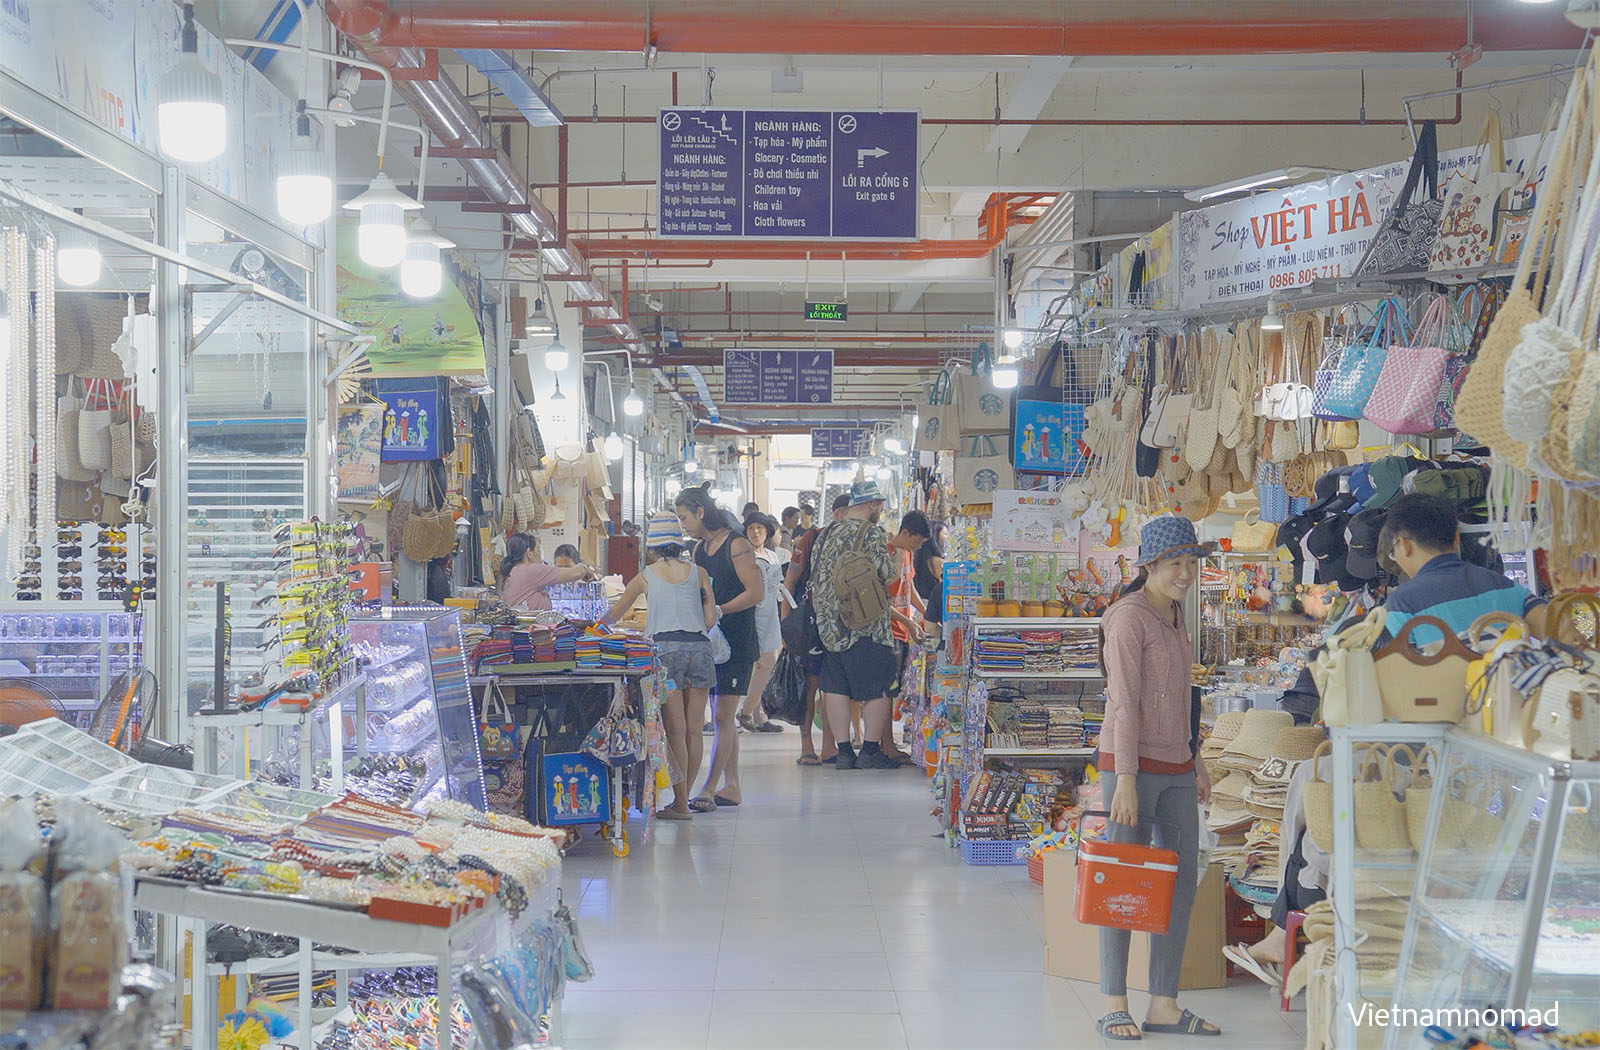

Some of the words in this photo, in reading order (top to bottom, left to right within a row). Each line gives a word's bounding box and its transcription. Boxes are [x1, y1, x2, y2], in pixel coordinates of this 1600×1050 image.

[754, 120, 788, 132] NGÀNH
[792, 120, 822, 132] HÀNG:
[754, 136, 768, 149] Tạp
[792, 137, 804, 149] Mỹ
[806, 135, 827, 149] phẩm
[674, 153, 700, 164] NGÀNH
[702, 153, 726, 164] HÀNG:
[755, 153, 784, 165] Glocery
[791, 153, 827, 164] Cosmetic
[754, 168, 764, 179] Đồ
[766, 169, 783, 179] chơi
[785, 168, 804, 179] thiếu
[807, 169, 818, 179] nhi
[842, 173, 857, 187] LỐI
[860, 176, 872, 187] RA
[875, 172, 899, 188] CỔNG
[902, 176, 909, 187] 6
[754, 184, 786, 195] Children
[789, 186, 801, 196] toy
[856, 191, 870, 200] Exit
[872, 192, 888, 203] gate
[890, 192, 895, 200] 6
[753, 201, 768, 210] Hoa
[771, 200, 782, 210] vải
[754, 216, 775, 227] Cloth
[777, 217, 806, 227] flowers
[1211, 221, 1250, 252] Shop
[1250, 198, 1318, 252] VIỆT
[1327, 180, 1373, 235] HÀ
[1204, 269, 1216, 282] TẠP
[1217, 266, 1229, 279] HÓA
[1234, 263, 1244, 276] MỸ
[1244, 260, 1261, 275] NGHỆ
[1266, 256, 1277, 270] MỸ
[1278, 252, 1297, 267] PHẨM
[1317, 245, 1334, 261] NIỆM
[1218, 283, 1237, 297] ĐIỆN
[1269, 272, 1295, 289] 0986
[1298, 269, 1318, 283] 805
[1322, 263, 1342, 279] 711
[1105, 1012, 1130, 1021] GUCC
